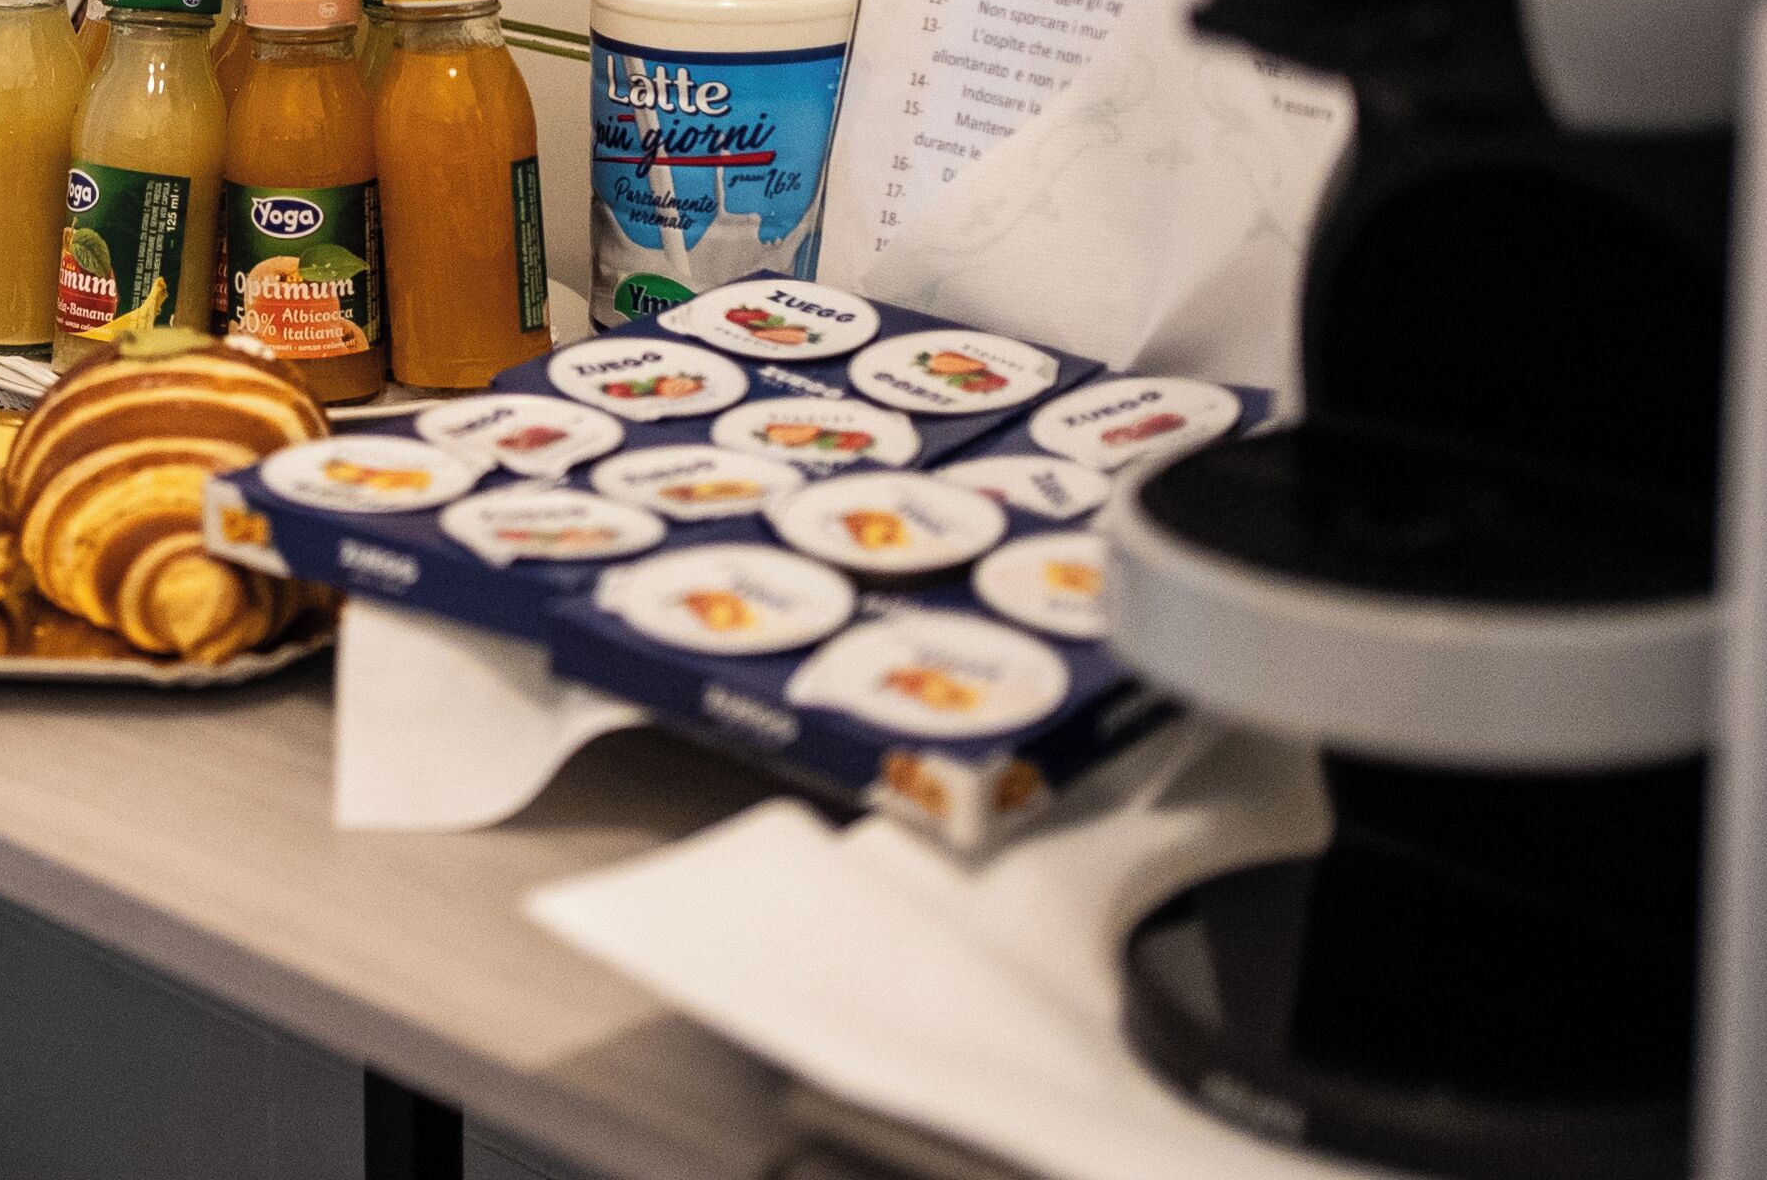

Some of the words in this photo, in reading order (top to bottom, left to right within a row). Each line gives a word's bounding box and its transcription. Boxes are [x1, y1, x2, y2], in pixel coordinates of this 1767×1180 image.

[978, 0, 1006, 20] Non
[1010, 10, 1069, 33] sporcare
[1080, 24, 1109, 41] mur
[1105, 0, 1123, 17] og
[922, 17, 941, 32] 13-
[973, 28, 1025, 54] L'ospite
[1028, 41, 1051, 59] che
[1055, 48, 1083, 66] non
[932, 49, 1010, 78] allontanato
[1014, 67, 1025, 81] e
[1028, 72, 1054, 89] non
[607, 54, 730, 116] Latte
[910, 72, 929, 88] 14-
[961, 84, 1026, 111] Indossare
[904, 99, 924, 116] 15-
[635, 113, 775, 178] giorni
[914, 132, 967, 157] durante
[892, 155, 913, 171] 16-
[68, 181, 92, 206] oga
[614, 176, 718, 214] Parzialmente
[764, 168, 801, 199] 1,6%
[886, 183, 906, 198] 17-
[168, 193, 179, 209] ml
[259, 200, 315, 233] Yoga
[165, 210, 177, 232] 125
[880, 210, 901, 226] 18-
[235, 270, 354, 306] Optimum
[236, 306, 277, 337] 50%
[282, 307, 354, 324] Albicocca
[766, 290, 856, 323] ZUEGG
[283, 326, 344, 341] Italiana
[571, 351, 662, 375] ZUEGG
[1062, 391, 1163, 428] ZUEGG
